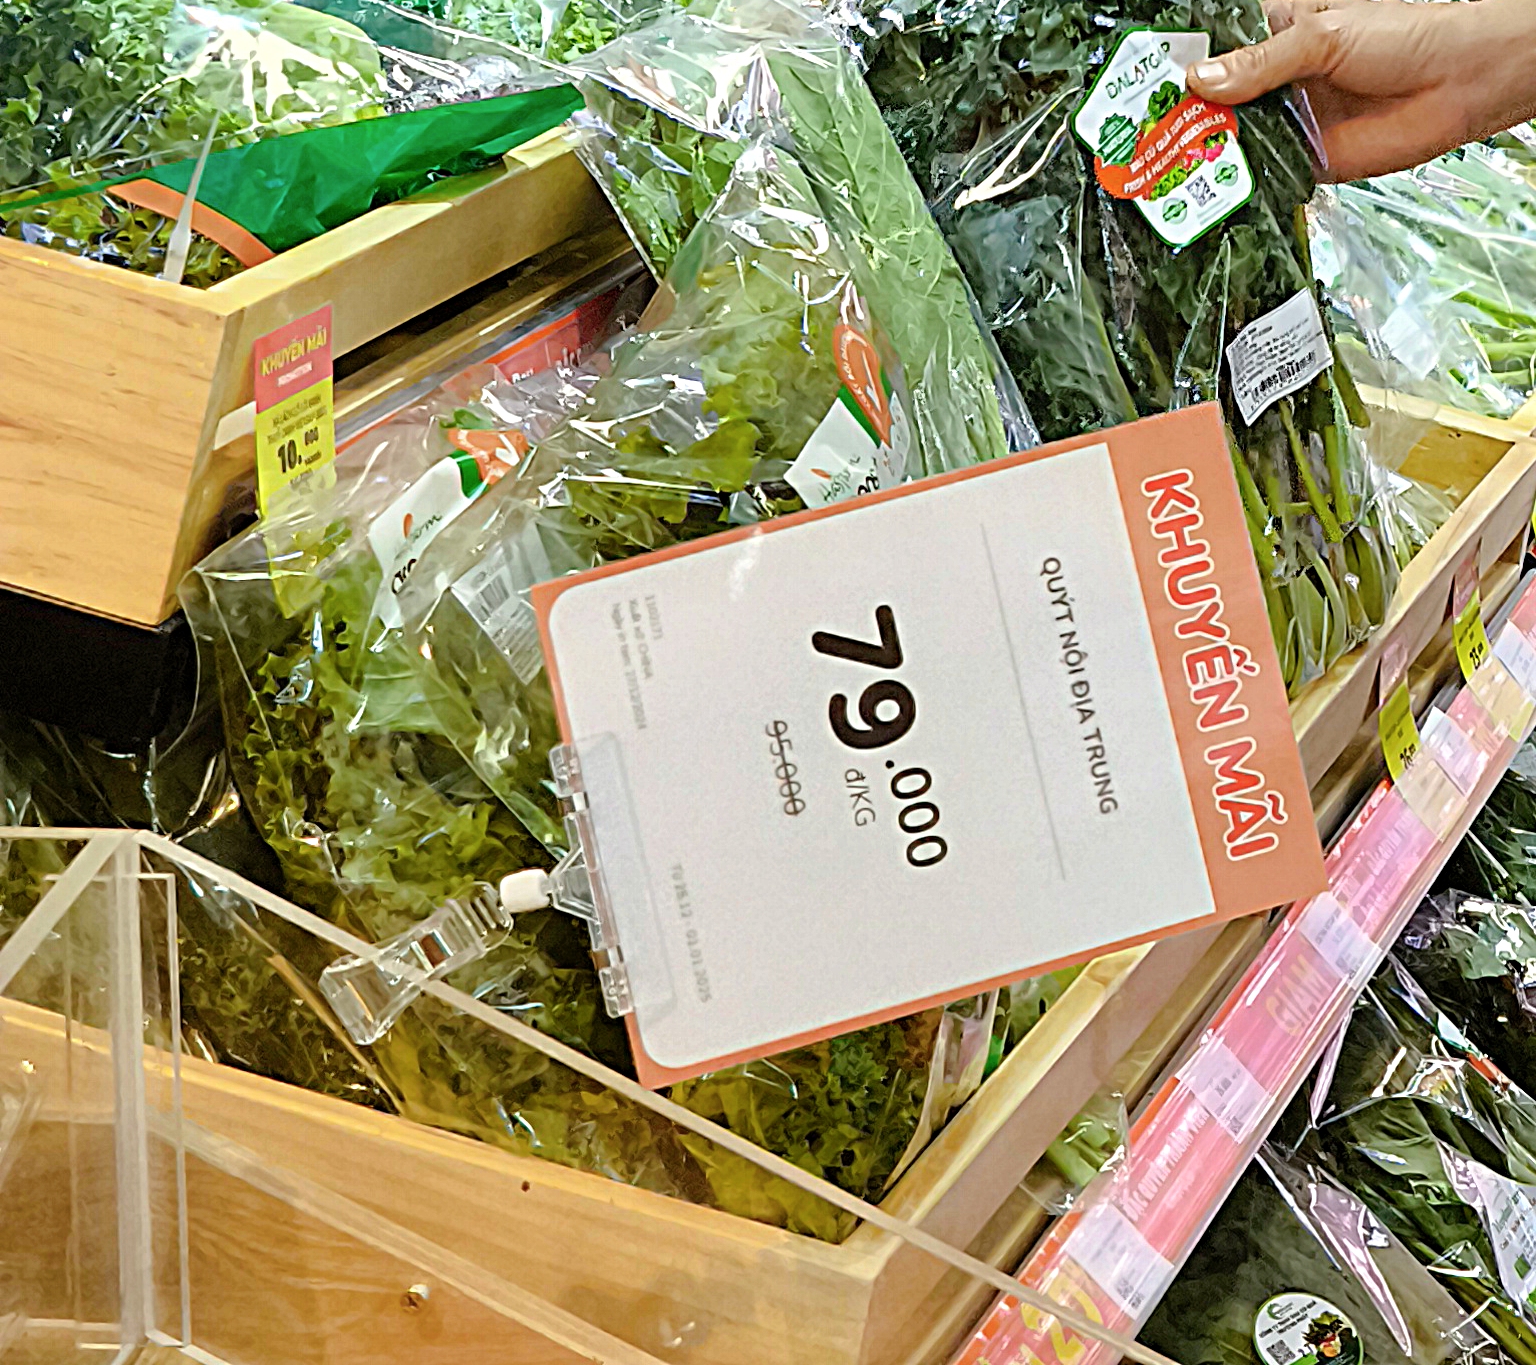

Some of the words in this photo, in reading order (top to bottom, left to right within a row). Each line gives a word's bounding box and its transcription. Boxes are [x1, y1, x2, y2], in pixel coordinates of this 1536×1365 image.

[260, 338, 305, 377] KHUYẾN
[305, 324, 328, 353] MÃI
[1039, 556, 1075, 626] QUÝT
[1058, 628, 1089, 677] NỘI
[1140, 467, 1261, 734] KHUYẾN
[1203, 734, 1290, 862] MÃI
[1068, 678, 1097, 726] ĐỊA
[765, 719, 806, 817] 95.000
[844, 767, 877, 827] đ/KG
[1082, 726, 1120, 816] TRUNG
